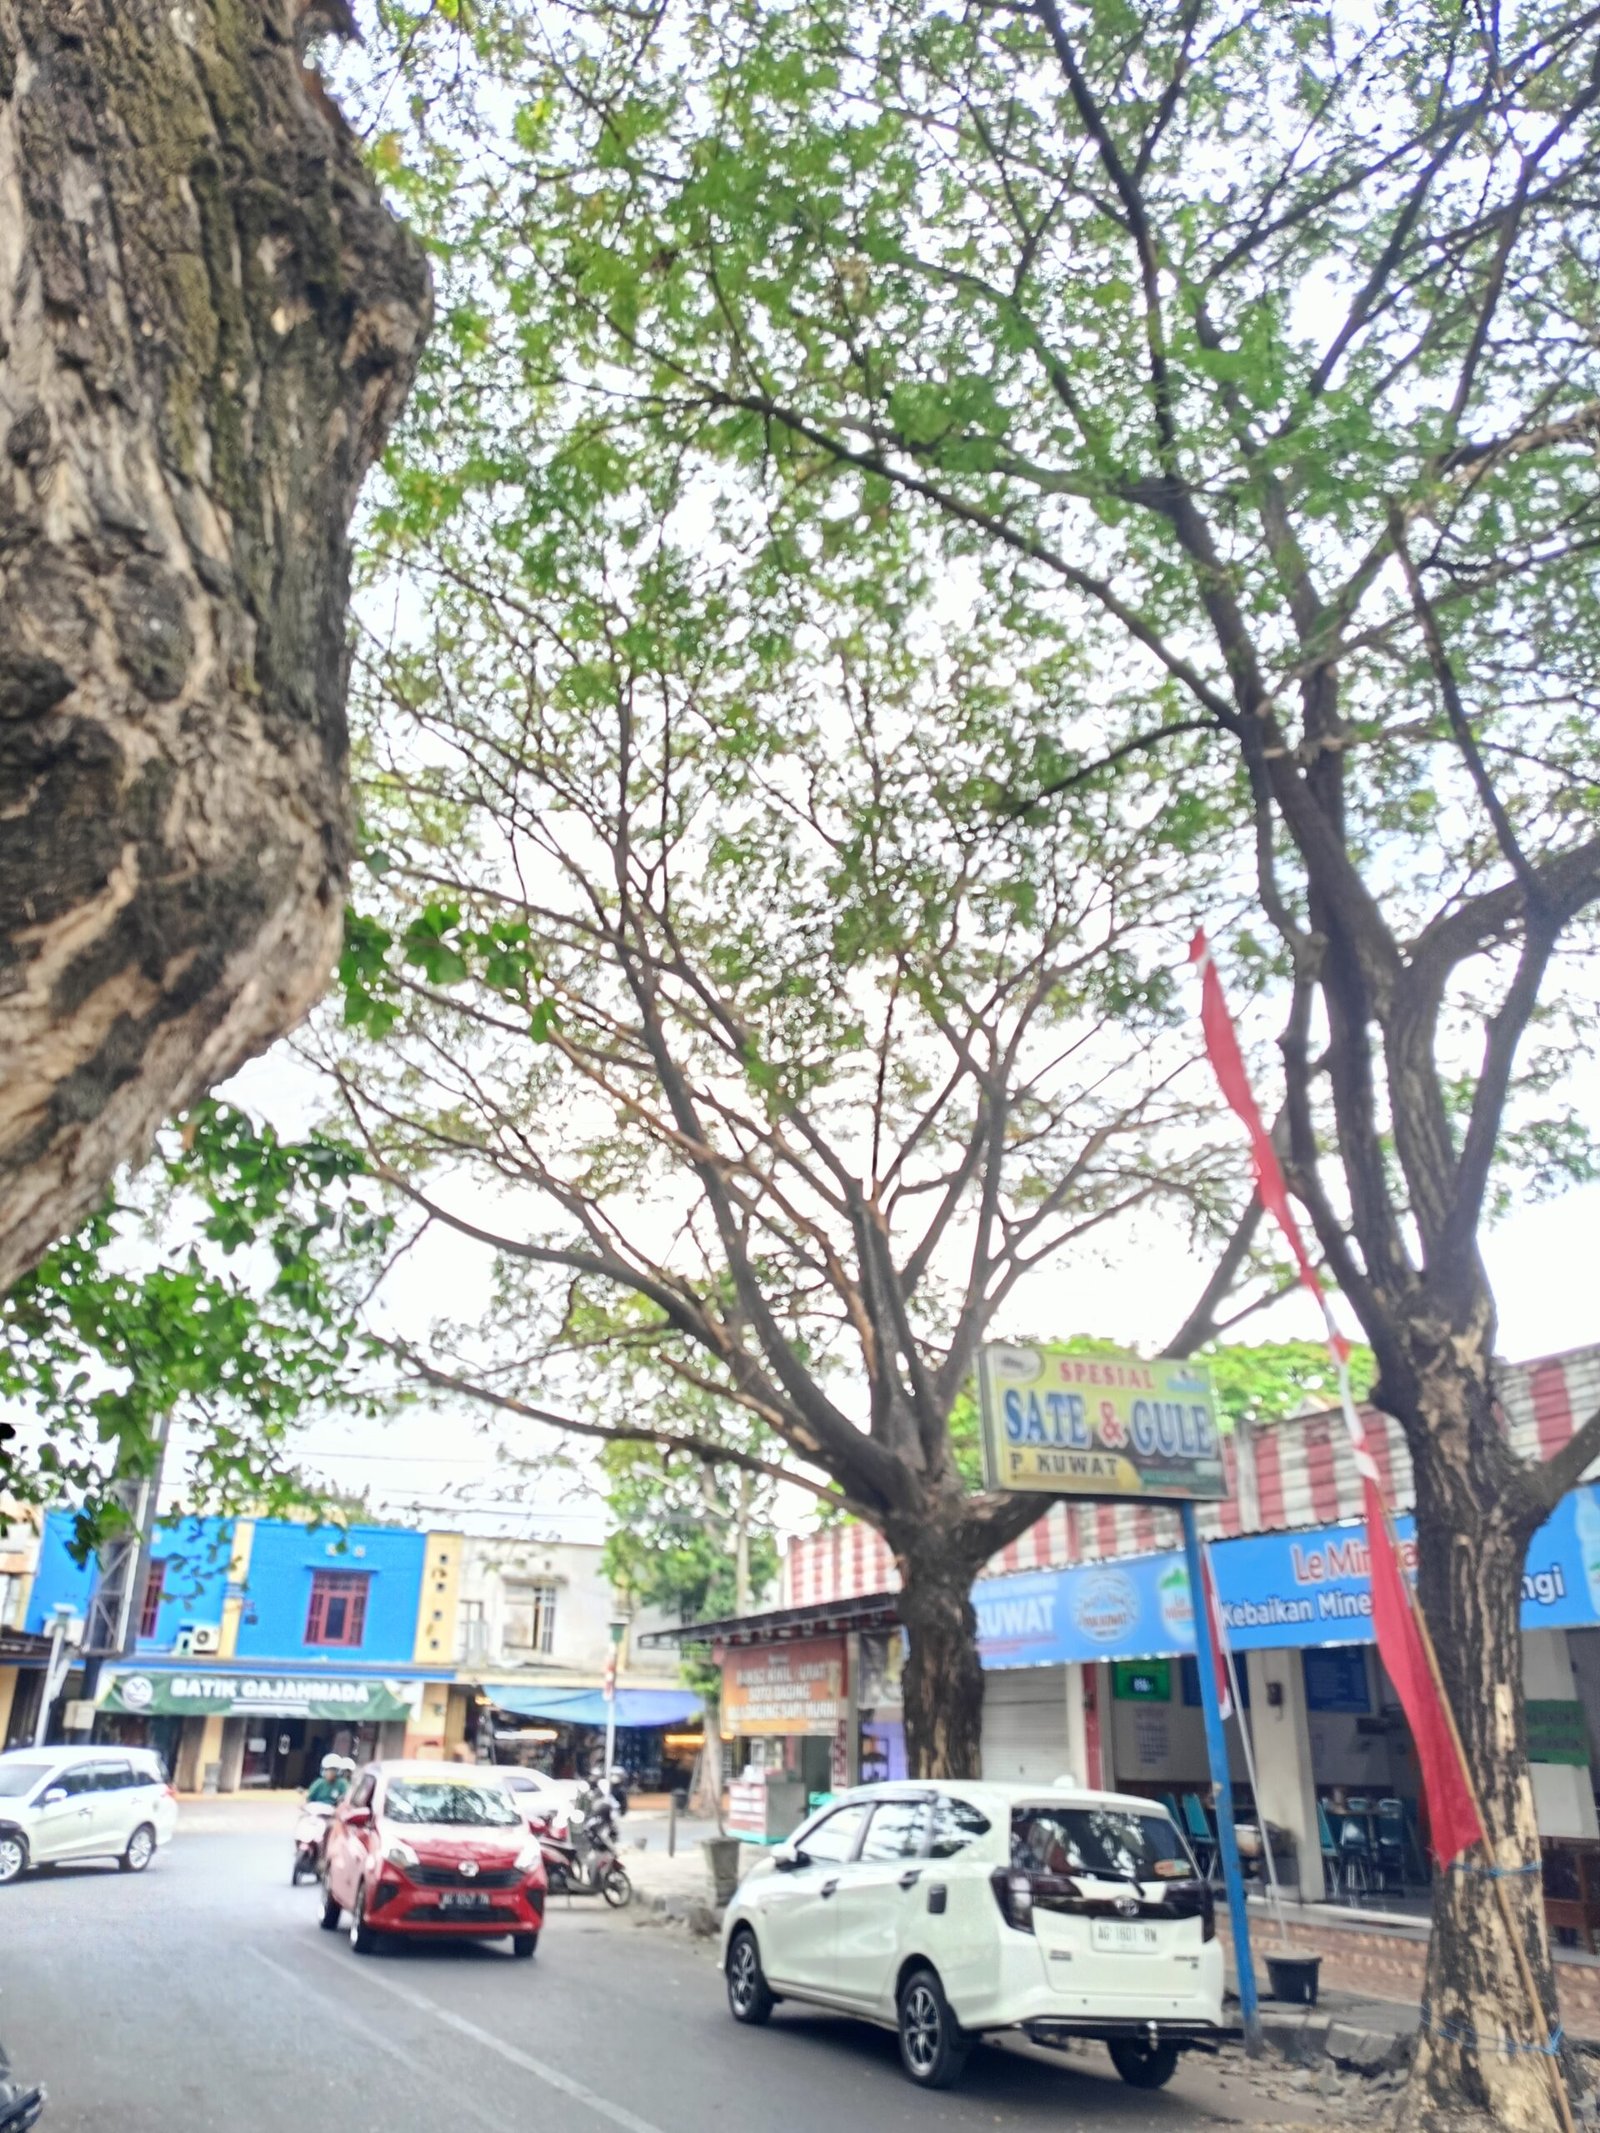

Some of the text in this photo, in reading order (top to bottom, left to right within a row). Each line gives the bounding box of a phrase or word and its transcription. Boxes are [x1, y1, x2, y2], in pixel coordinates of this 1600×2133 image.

[1059, 1361, 1155, 1389] SPESIAL
[1003, 1387, 1216, 1458] SATE & GULE
[1036, 1454, 1117, 1476] KUWAT
[1291, 1544, 1324, 1584] Le
[1222, 1597, 1314, 1629] Kebaikan
[170, 1678, 369, 1702] BATIK GAJAHMADA
